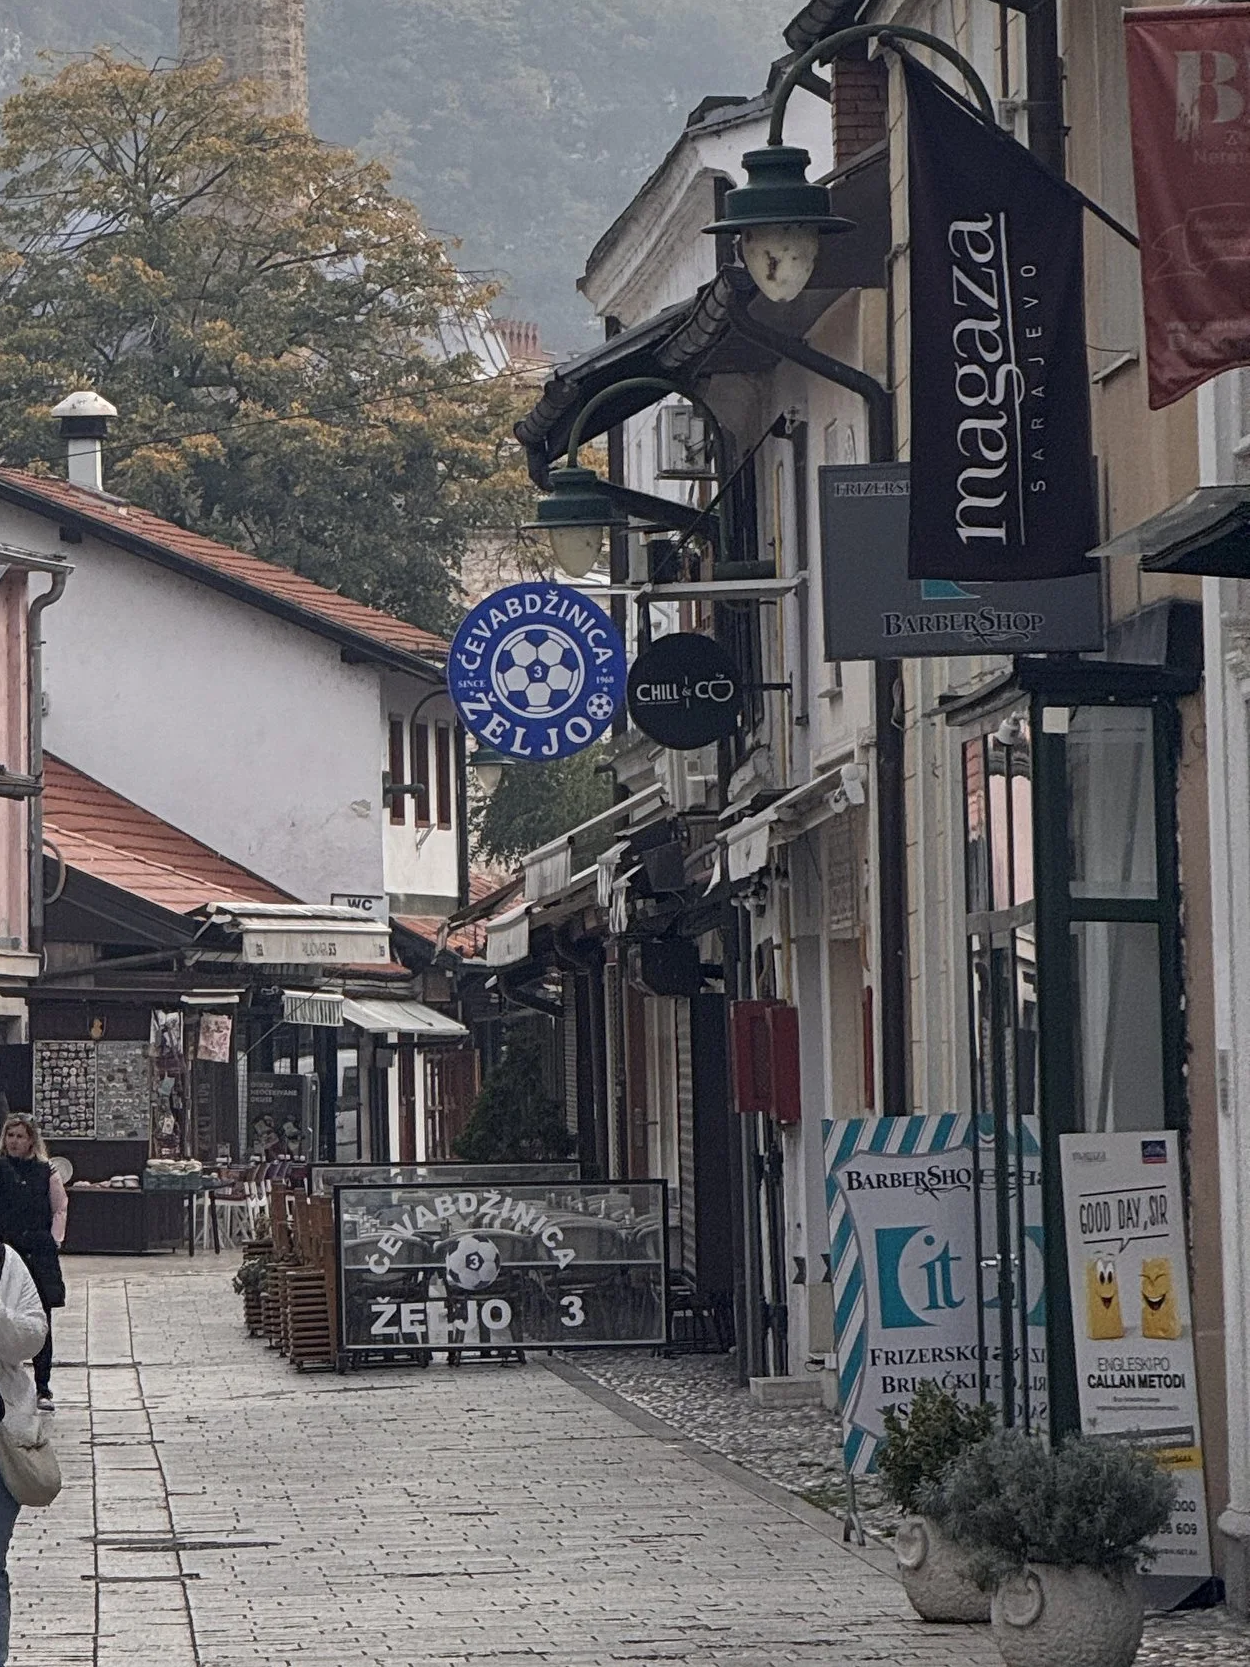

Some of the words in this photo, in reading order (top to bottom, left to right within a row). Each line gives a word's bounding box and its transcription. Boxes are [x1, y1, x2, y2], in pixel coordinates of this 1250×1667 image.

[948, 212, 1025, 545] magaza
[1020, 265, 1047, 492] SARAJEVO
[834, 480, 910, 497] FRIZERS
[456, 590, 614, 671] ĆEVABDŽINICA
[533, 666, 543, 678] 3
[596, 676, 615, 684] 1968
[458, 679, 487, 688] SINCE
[636, 683, 680, 702] CHILL
[460, 691, 593, 756] ŽELJO
[347, 898, 374, 912] WC
[1079, 1200, 1111, 1235] GOOD
[365, 1189, 577, 1275] ĆEVABDŽINICA
[468, 1255, 480, 1269] 3
[370, 1296, 513, 1335] ŽELJO
[559, 1295, 585, 1327] 3
[1087, 1374, 1136, 1389] CALLAN
[1137, 1373, 1185, 1389] METODI
